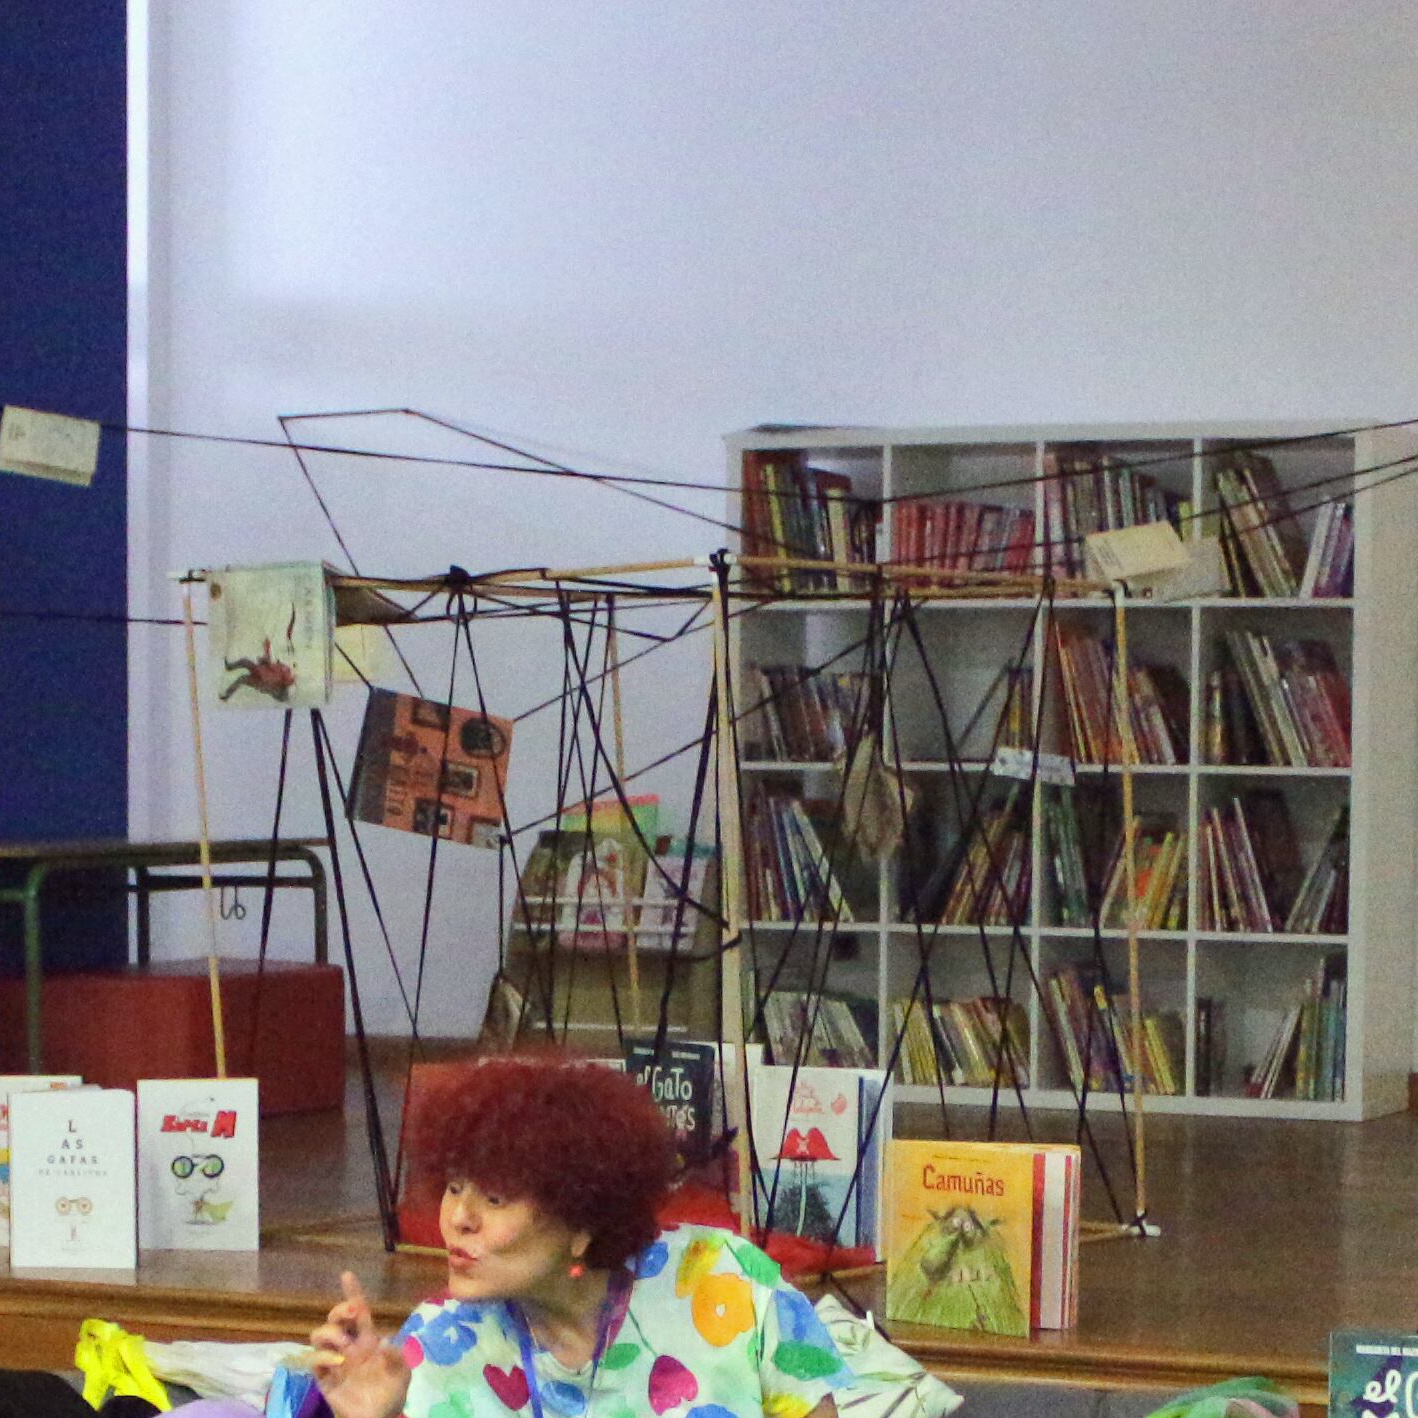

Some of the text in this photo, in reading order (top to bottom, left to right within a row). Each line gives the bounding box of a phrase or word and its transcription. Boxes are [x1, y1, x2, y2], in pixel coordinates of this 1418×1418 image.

[68, 1119, 77, 1133] L
[61, 1139, 84, 1150] AS
[47, 1156, 98, 1165] GAFAS
[922, 1163, 1005, 1197] Camuñas
[1363, 1369, 1402, 1404] el
